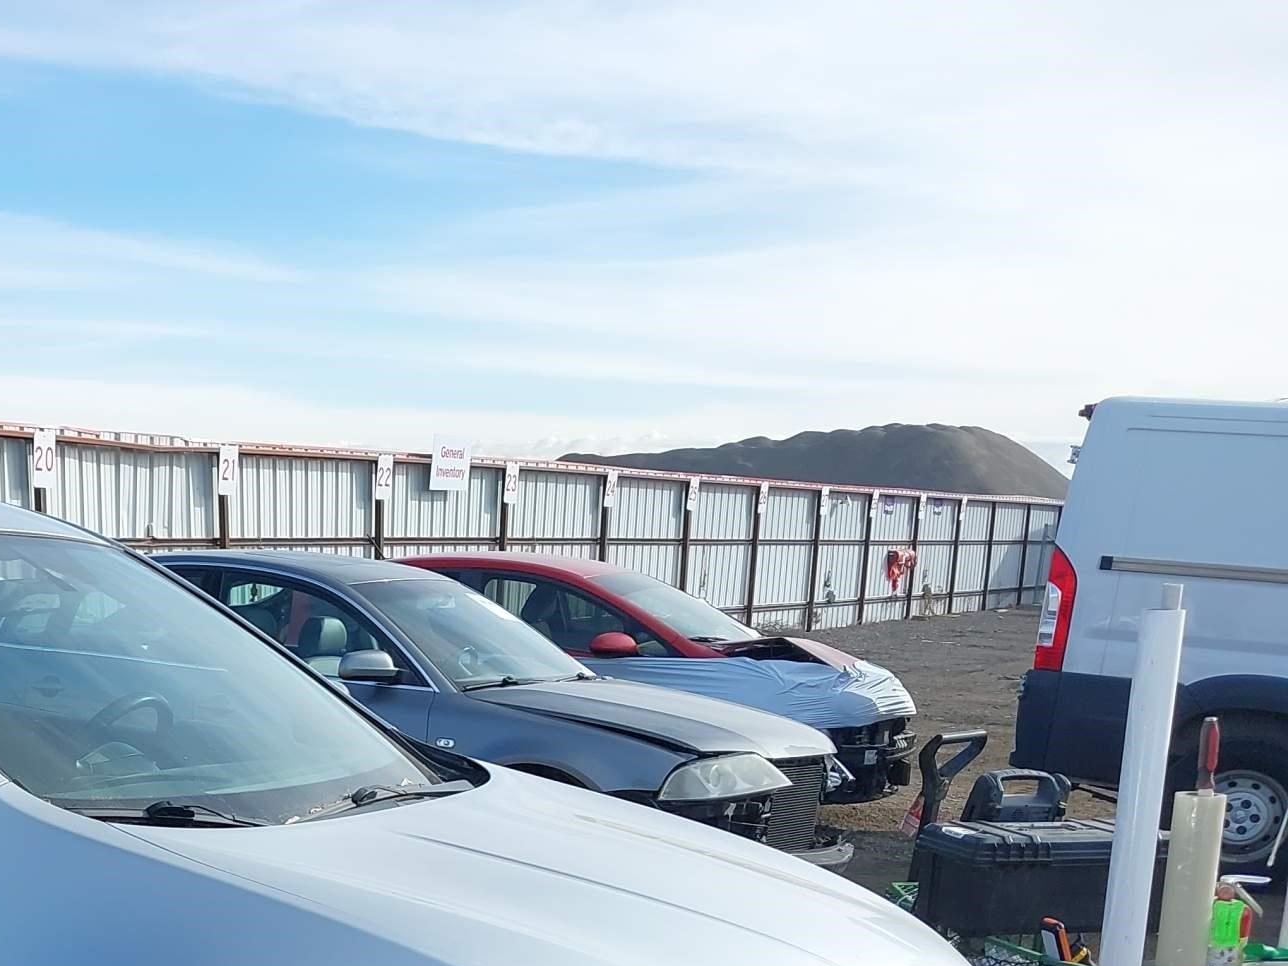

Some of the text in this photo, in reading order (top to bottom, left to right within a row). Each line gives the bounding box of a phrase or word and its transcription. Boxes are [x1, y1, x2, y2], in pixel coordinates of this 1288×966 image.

[34, 446, 54, 472] 20
[440, 445, 466, 460] General
[222, 458, 235, 481] 21
[377, 466, 392, 487] 22
[435, 465, 466, 481] Inventory
[505, 473, 517, 492] 23
